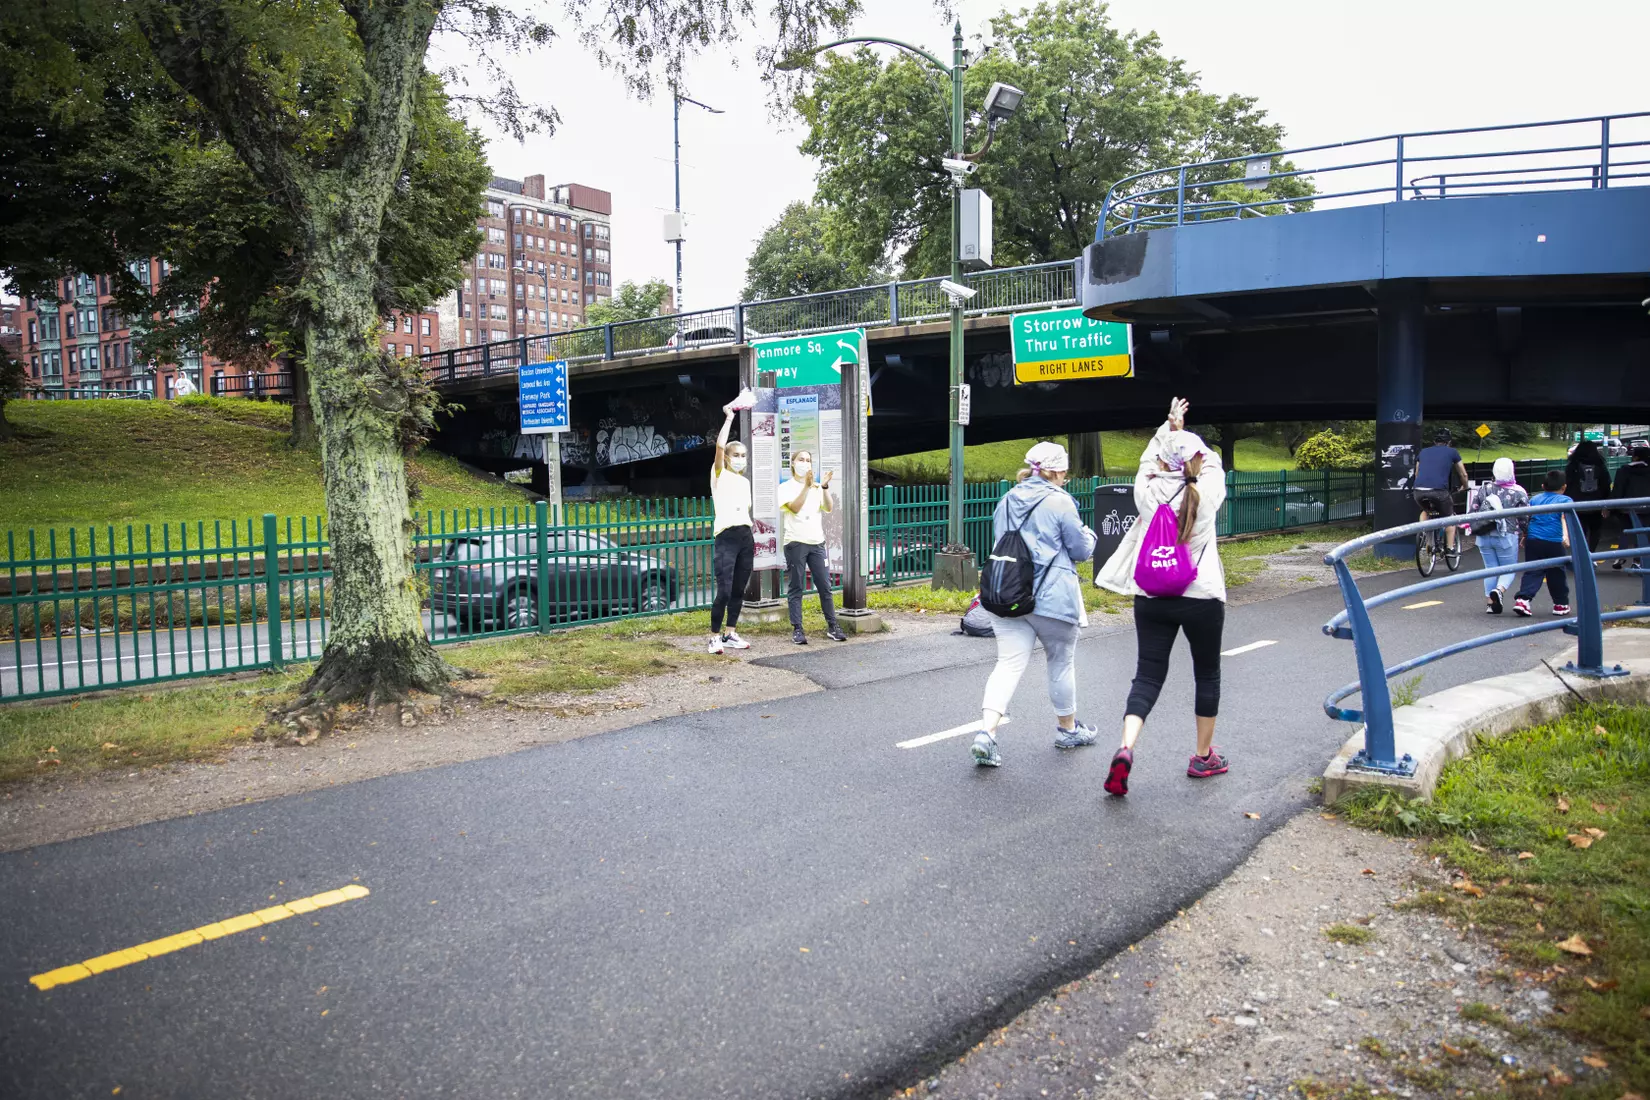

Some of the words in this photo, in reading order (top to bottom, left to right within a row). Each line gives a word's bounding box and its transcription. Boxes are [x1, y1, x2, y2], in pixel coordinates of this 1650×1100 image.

[1024, 318, 1082, 333] Storrow
[808, 341, 824, 355] Sq.
[1026, 338, 1057, 352] Thru
[1062, 332, 1112, 348] Traffic
[535, 366, 554, 374] University
[1040, 362, 1066, 375] RIGHT
[1072, 360, 1104, 372] LANES
[786, 396, 816, 404] ESPLANADE
[1152, 558, 1177, 568] CARES
